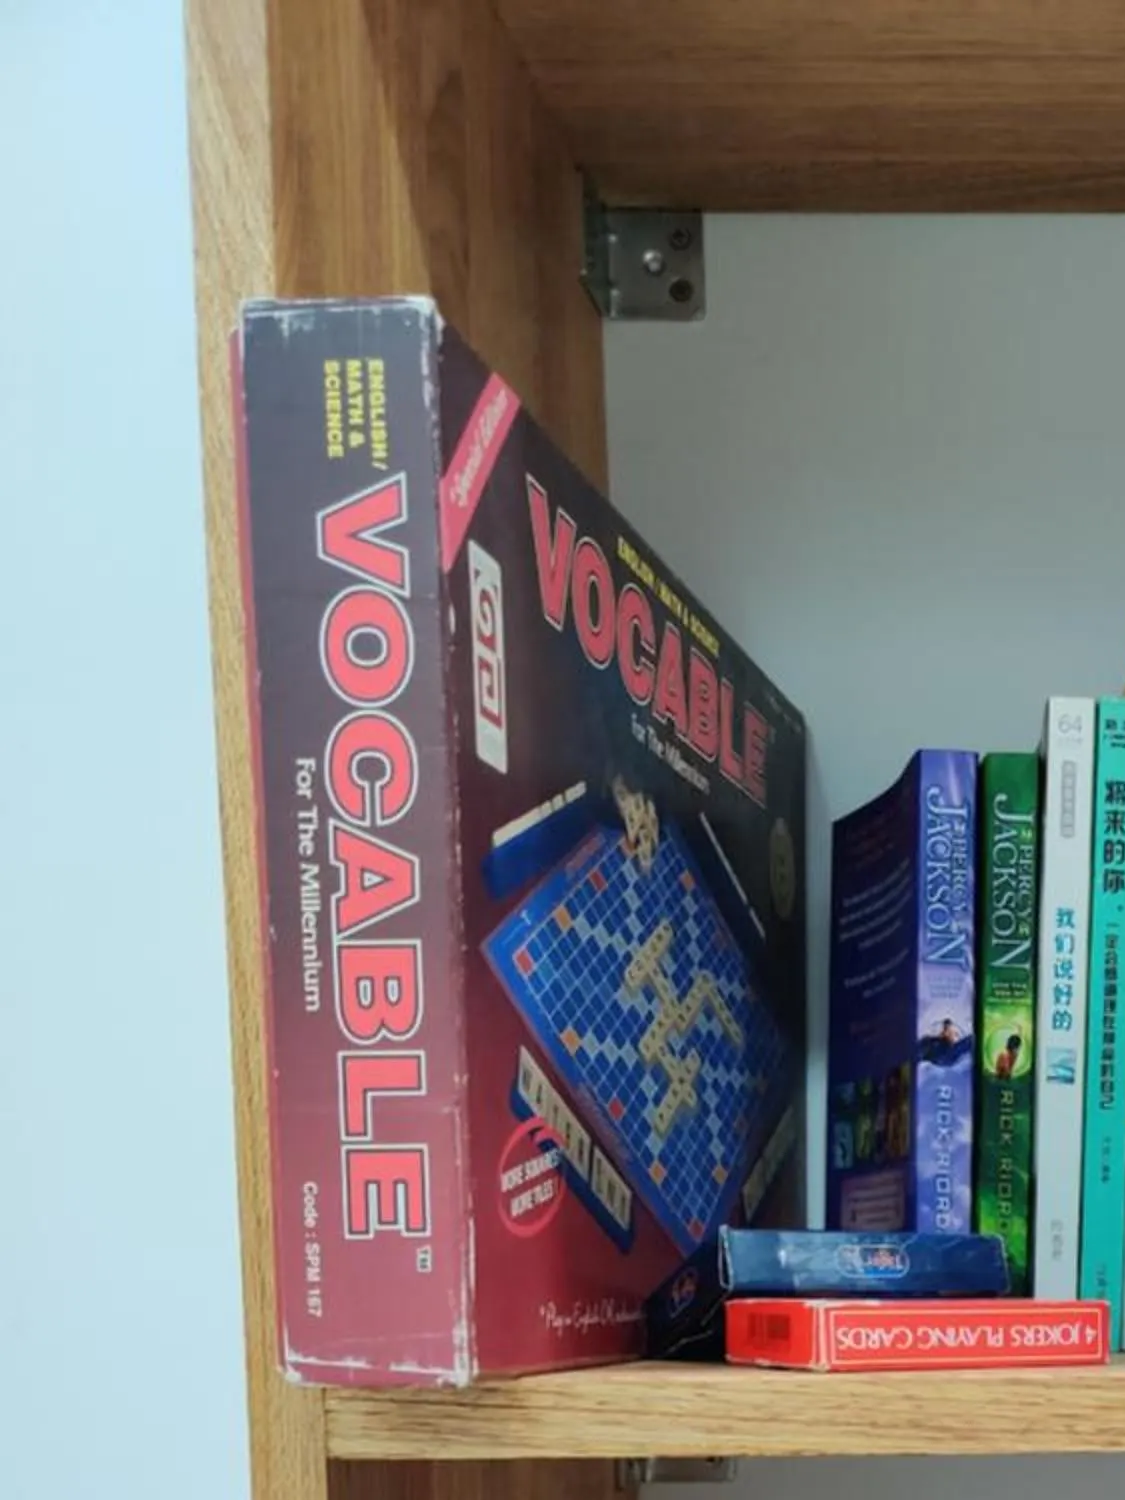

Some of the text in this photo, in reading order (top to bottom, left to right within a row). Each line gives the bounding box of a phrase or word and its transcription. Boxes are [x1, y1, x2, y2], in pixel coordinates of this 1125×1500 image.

[324, 359, 344, 458] SCIENCE
[346, 359, 364, 425] MATH
[525, 472, 771, 809] VOCABLE
[296, 757, 323, 1013] For The Millennium
[316, 471, 432, 1241] VOCABLE
[926, 785, 968, 970] JACKSON
[991, 792, 1035, 971] JACKSON
[1051, 907, 1075, 1032] 我们说好的
[935, 1085, 951, 1233] RICK RIORD
[1000, 1089, 1014, 1145] RICK
[303, 1181, 318, 1228] Code
[305, 1242, 321, 1282] SPM
[836, 1323, 1098, 1351] 4 JOKERS PLAYING CARDS
